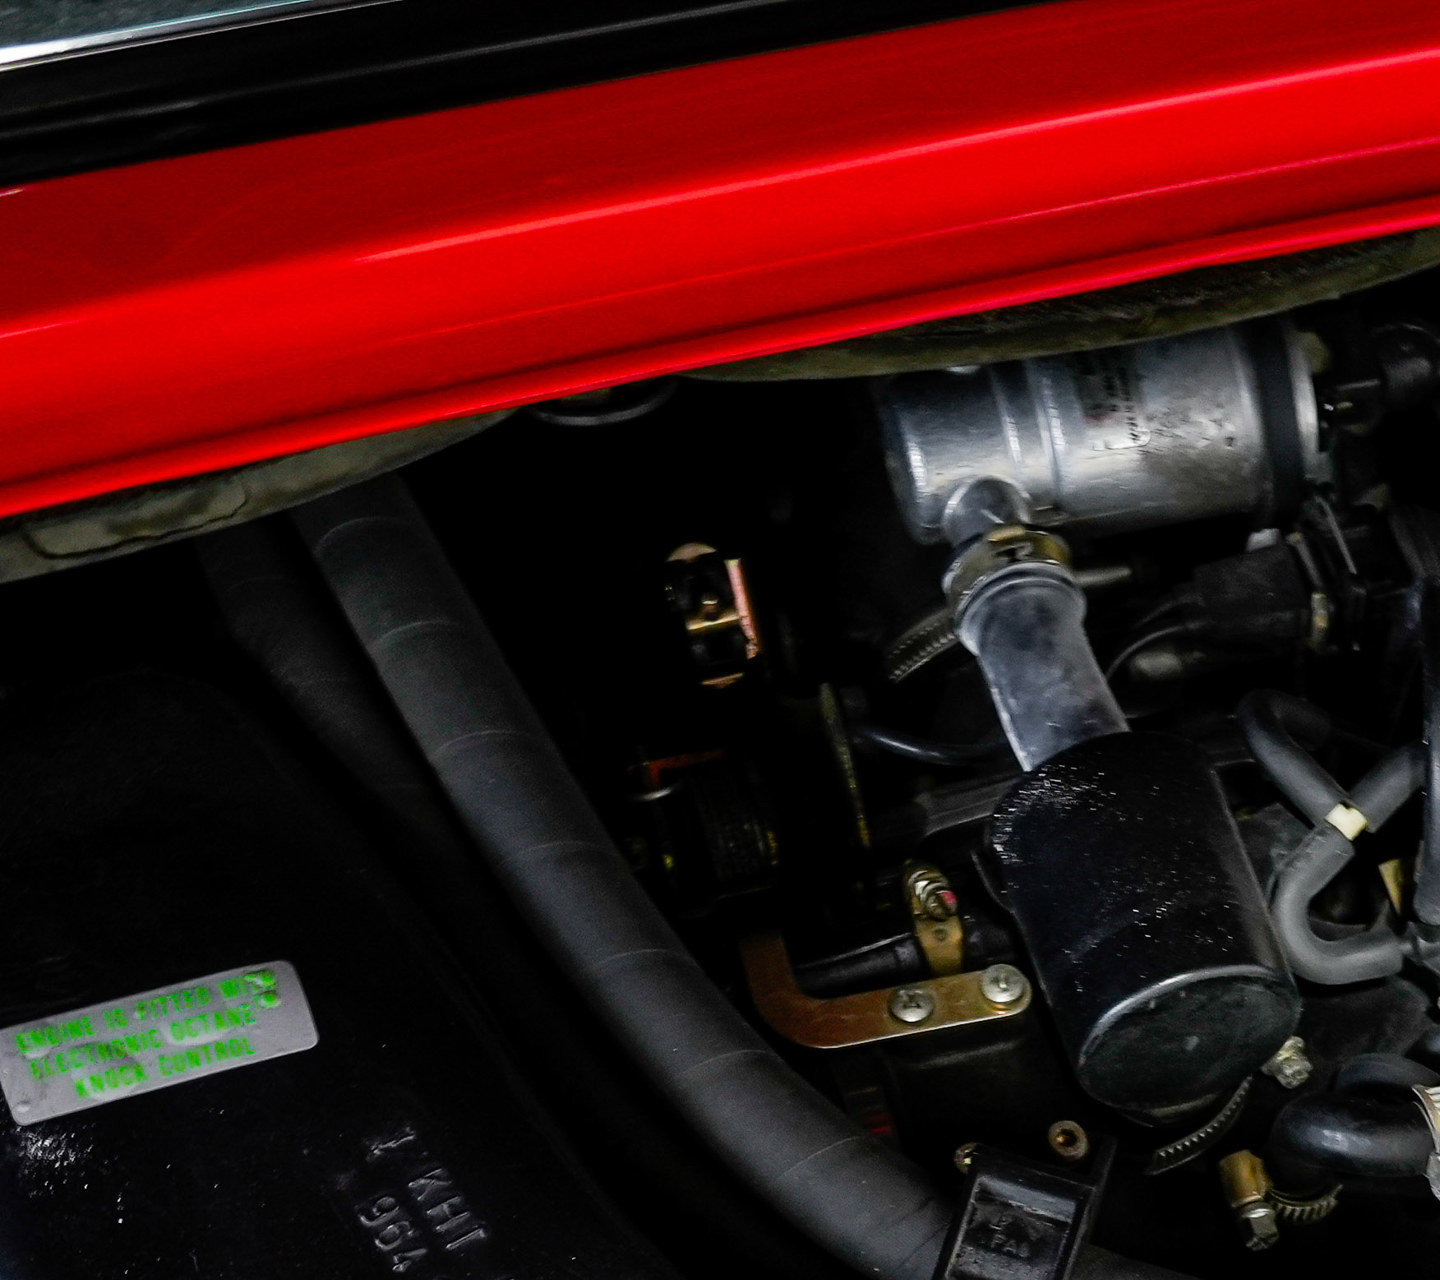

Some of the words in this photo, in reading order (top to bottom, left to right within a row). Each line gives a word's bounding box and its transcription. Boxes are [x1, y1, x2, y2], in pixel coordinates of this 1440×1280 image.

[16, 1017, 96, 1054] ENGINE
[104, 1008, 128, 1028] IS
[30, 1028, 161, 1081] ELECTRONIC
[170, 1003, 255, 1042] OCTANE
[76, 1063, 148, 1099] KNOCK
[158, 1036, 255, 1077] CONTROL
[356, 1195, 428, 1273] 964
